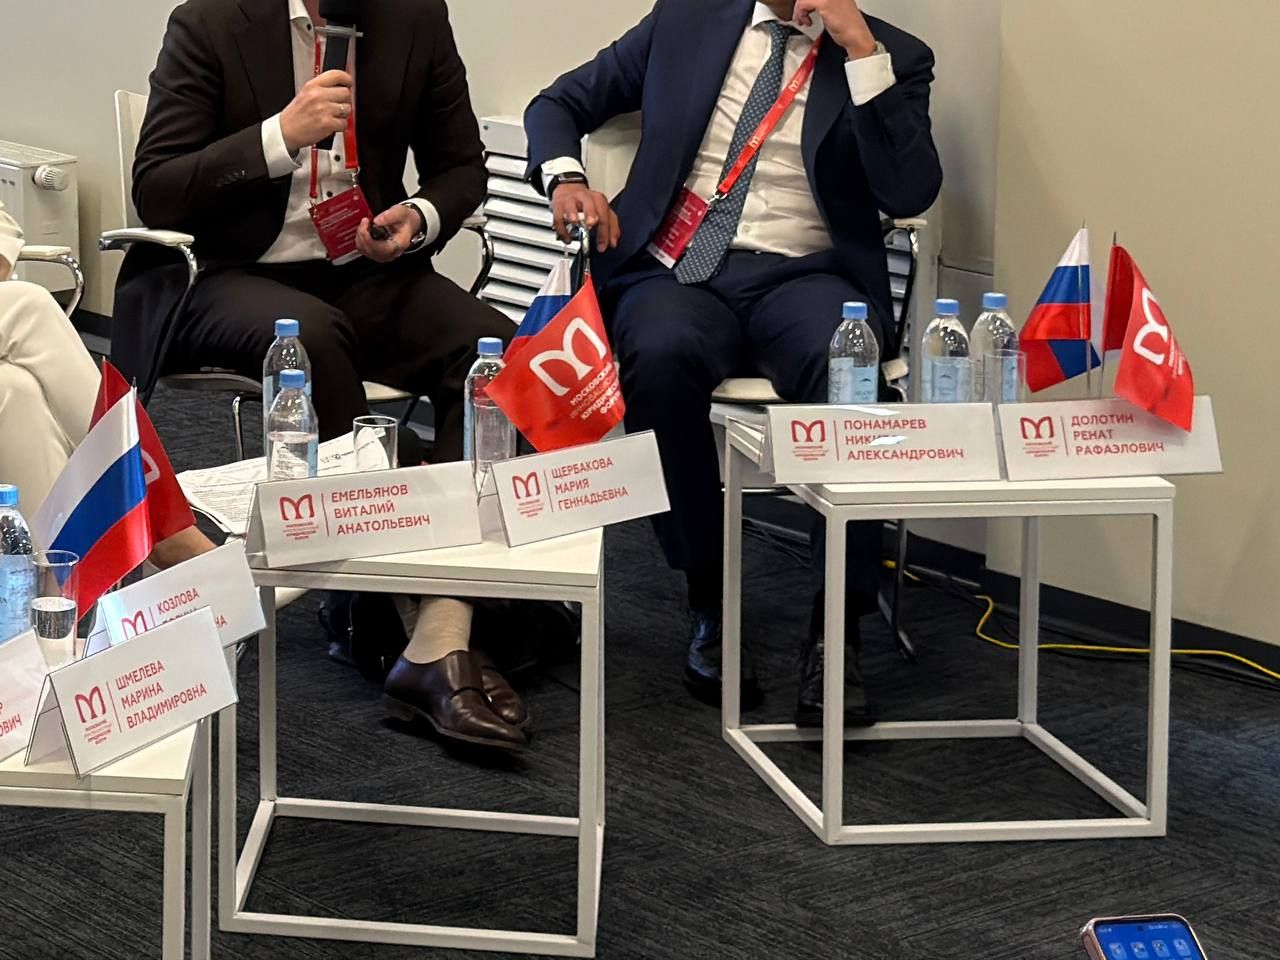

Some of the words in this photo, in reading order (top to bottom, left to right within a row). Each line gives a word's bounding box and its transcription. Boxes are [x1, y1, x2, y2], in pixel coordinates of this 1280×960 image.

[844, 418, 927, 430] ПОНАМАРЕВ
[1071, 413, 1134, 427] ДОЛОТИН
[845, 434, 902, 445] НИК
[1073, 429, 1114, 440] РЕНАТ
[848, 448, 965, 461] АЛЕКСАНДРОВИЧ
[1075, 442, 1165, 456] РАФАЭЛОВИЧ
[551, 456, 614, 479] ЩЕРБАКОВА
[331, 484, 409, 503] ЕМЕЛЬЯНОВ
[555, 478, 590, 495] МАРИЯ
[558, 486, 628, 511] ГЕННАДЬЕВНА
[334, 499, 396, 519] ВИТАЛИЙ
[337, 514, 431, 536] АНАТОЛЬЕВИЧ
[157, 587, 200, 615] КОЗЛОВА
[115, 660, 165, 690] ШМЕЛЕВА
[121, 681, 164, 710] МАРИНА
[126, 683, 207, 730] ВЛАДИМИРОВНА
